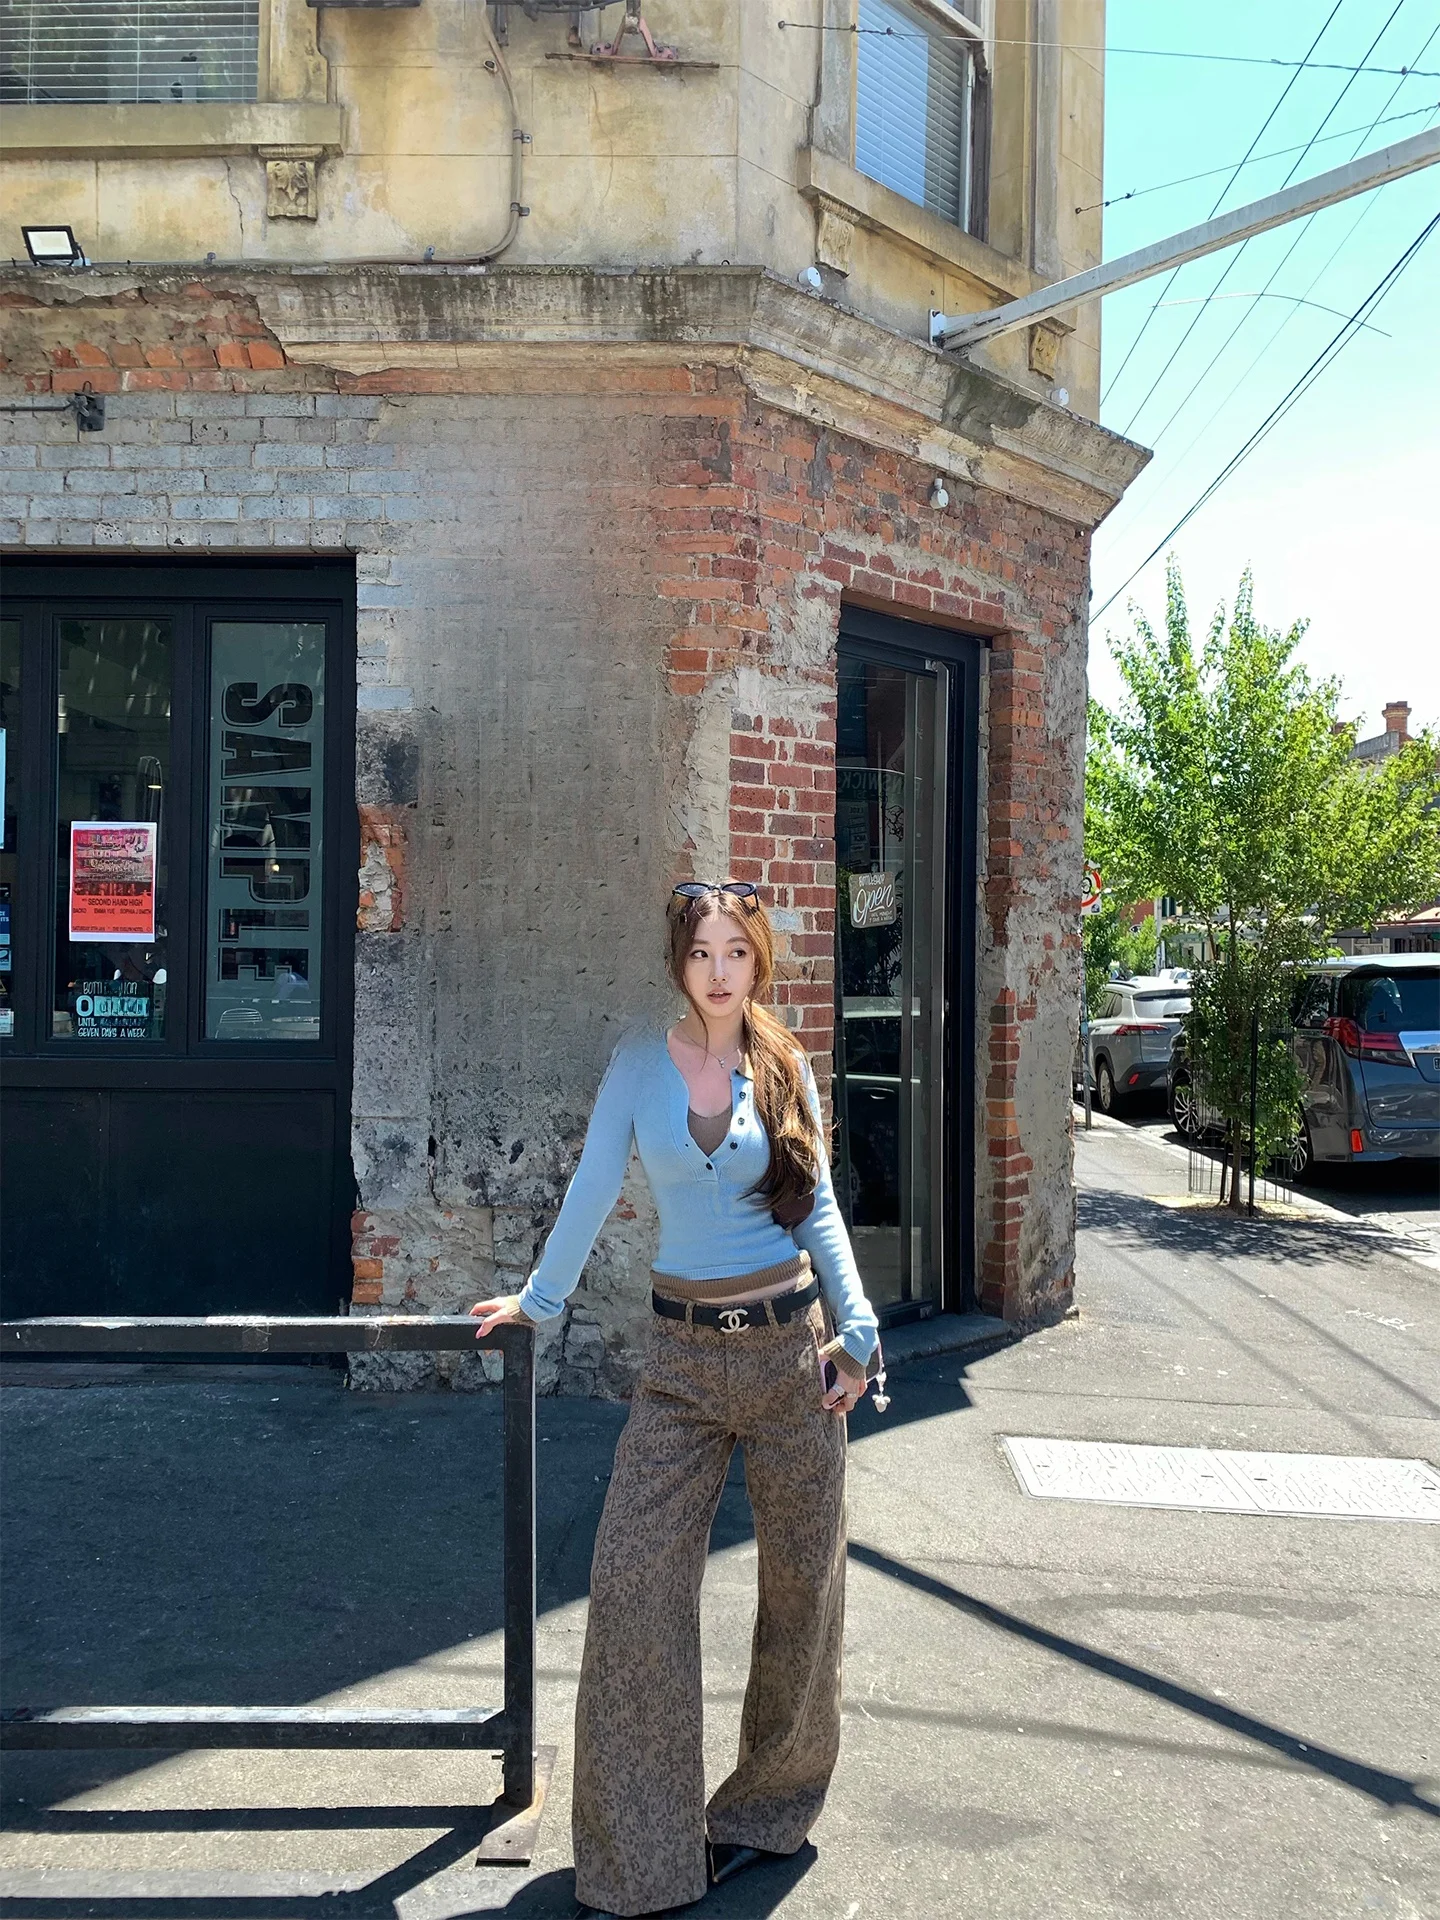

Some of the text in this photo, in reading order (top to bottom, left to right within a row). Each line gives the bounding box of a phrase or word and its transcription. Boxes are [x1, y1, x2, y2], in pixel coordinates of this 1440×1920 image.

[218, 681, 314, 982] SAMPLE
[87, 898, 111, 906] SECOND
[112, 898, 129, 906] HAND
[129, 898, 143, 907] HIGH
[853, 884, 894, 926] Open
[78, 1027, 146, 1038] SEVEN DAYS A WEEK
